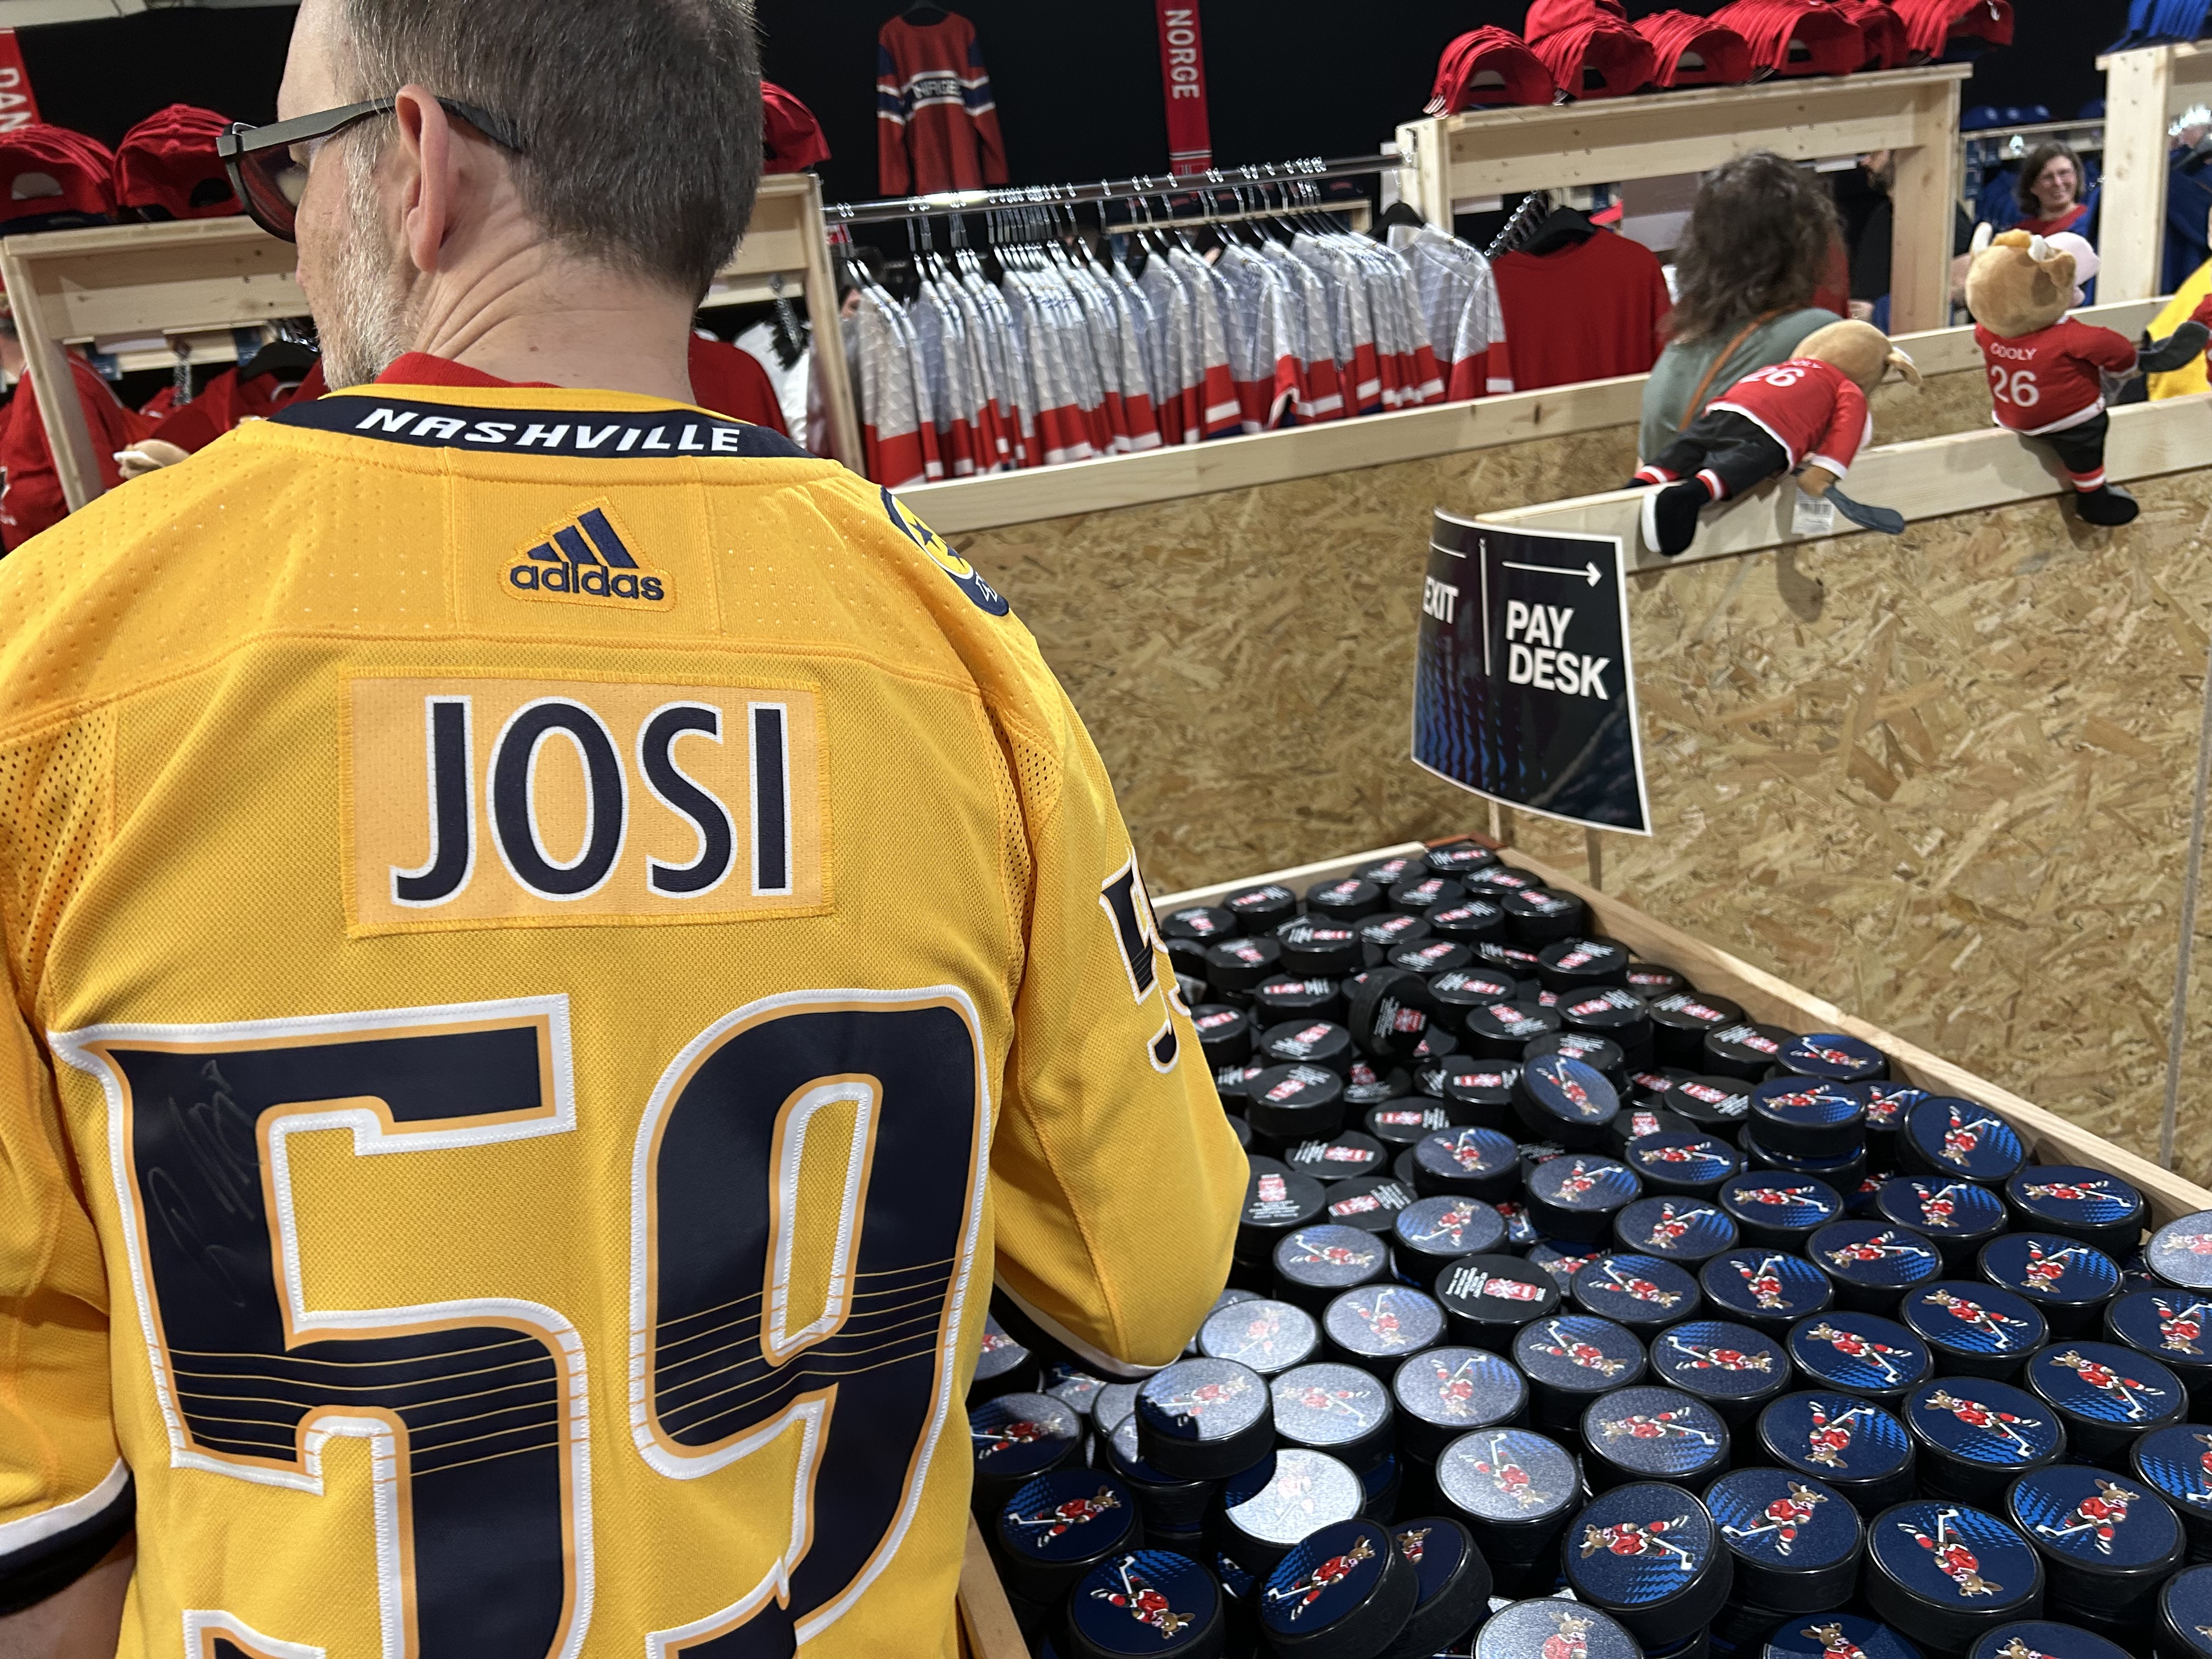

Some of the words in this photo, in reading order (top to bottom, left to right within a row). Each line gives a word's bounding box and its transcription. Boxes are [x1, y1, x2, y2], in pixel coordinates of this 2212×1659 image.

[1164, 9, 1200, 99] NORGE
[1738, 365, 1804, 387] 26
[1990, 364, 2040, 408] 26
[355, 408, 742, 453] NASHVILLE
[510, 562, 665, 601] adidas
[1422, 575, 1459, 624] EXIT
[1505, 599, 1575, 648] PAY
[1508, 642, 1611, 700] DESK
[389, 695, 793, 909] JOSI
[48, 984, 991, 1659] 59
